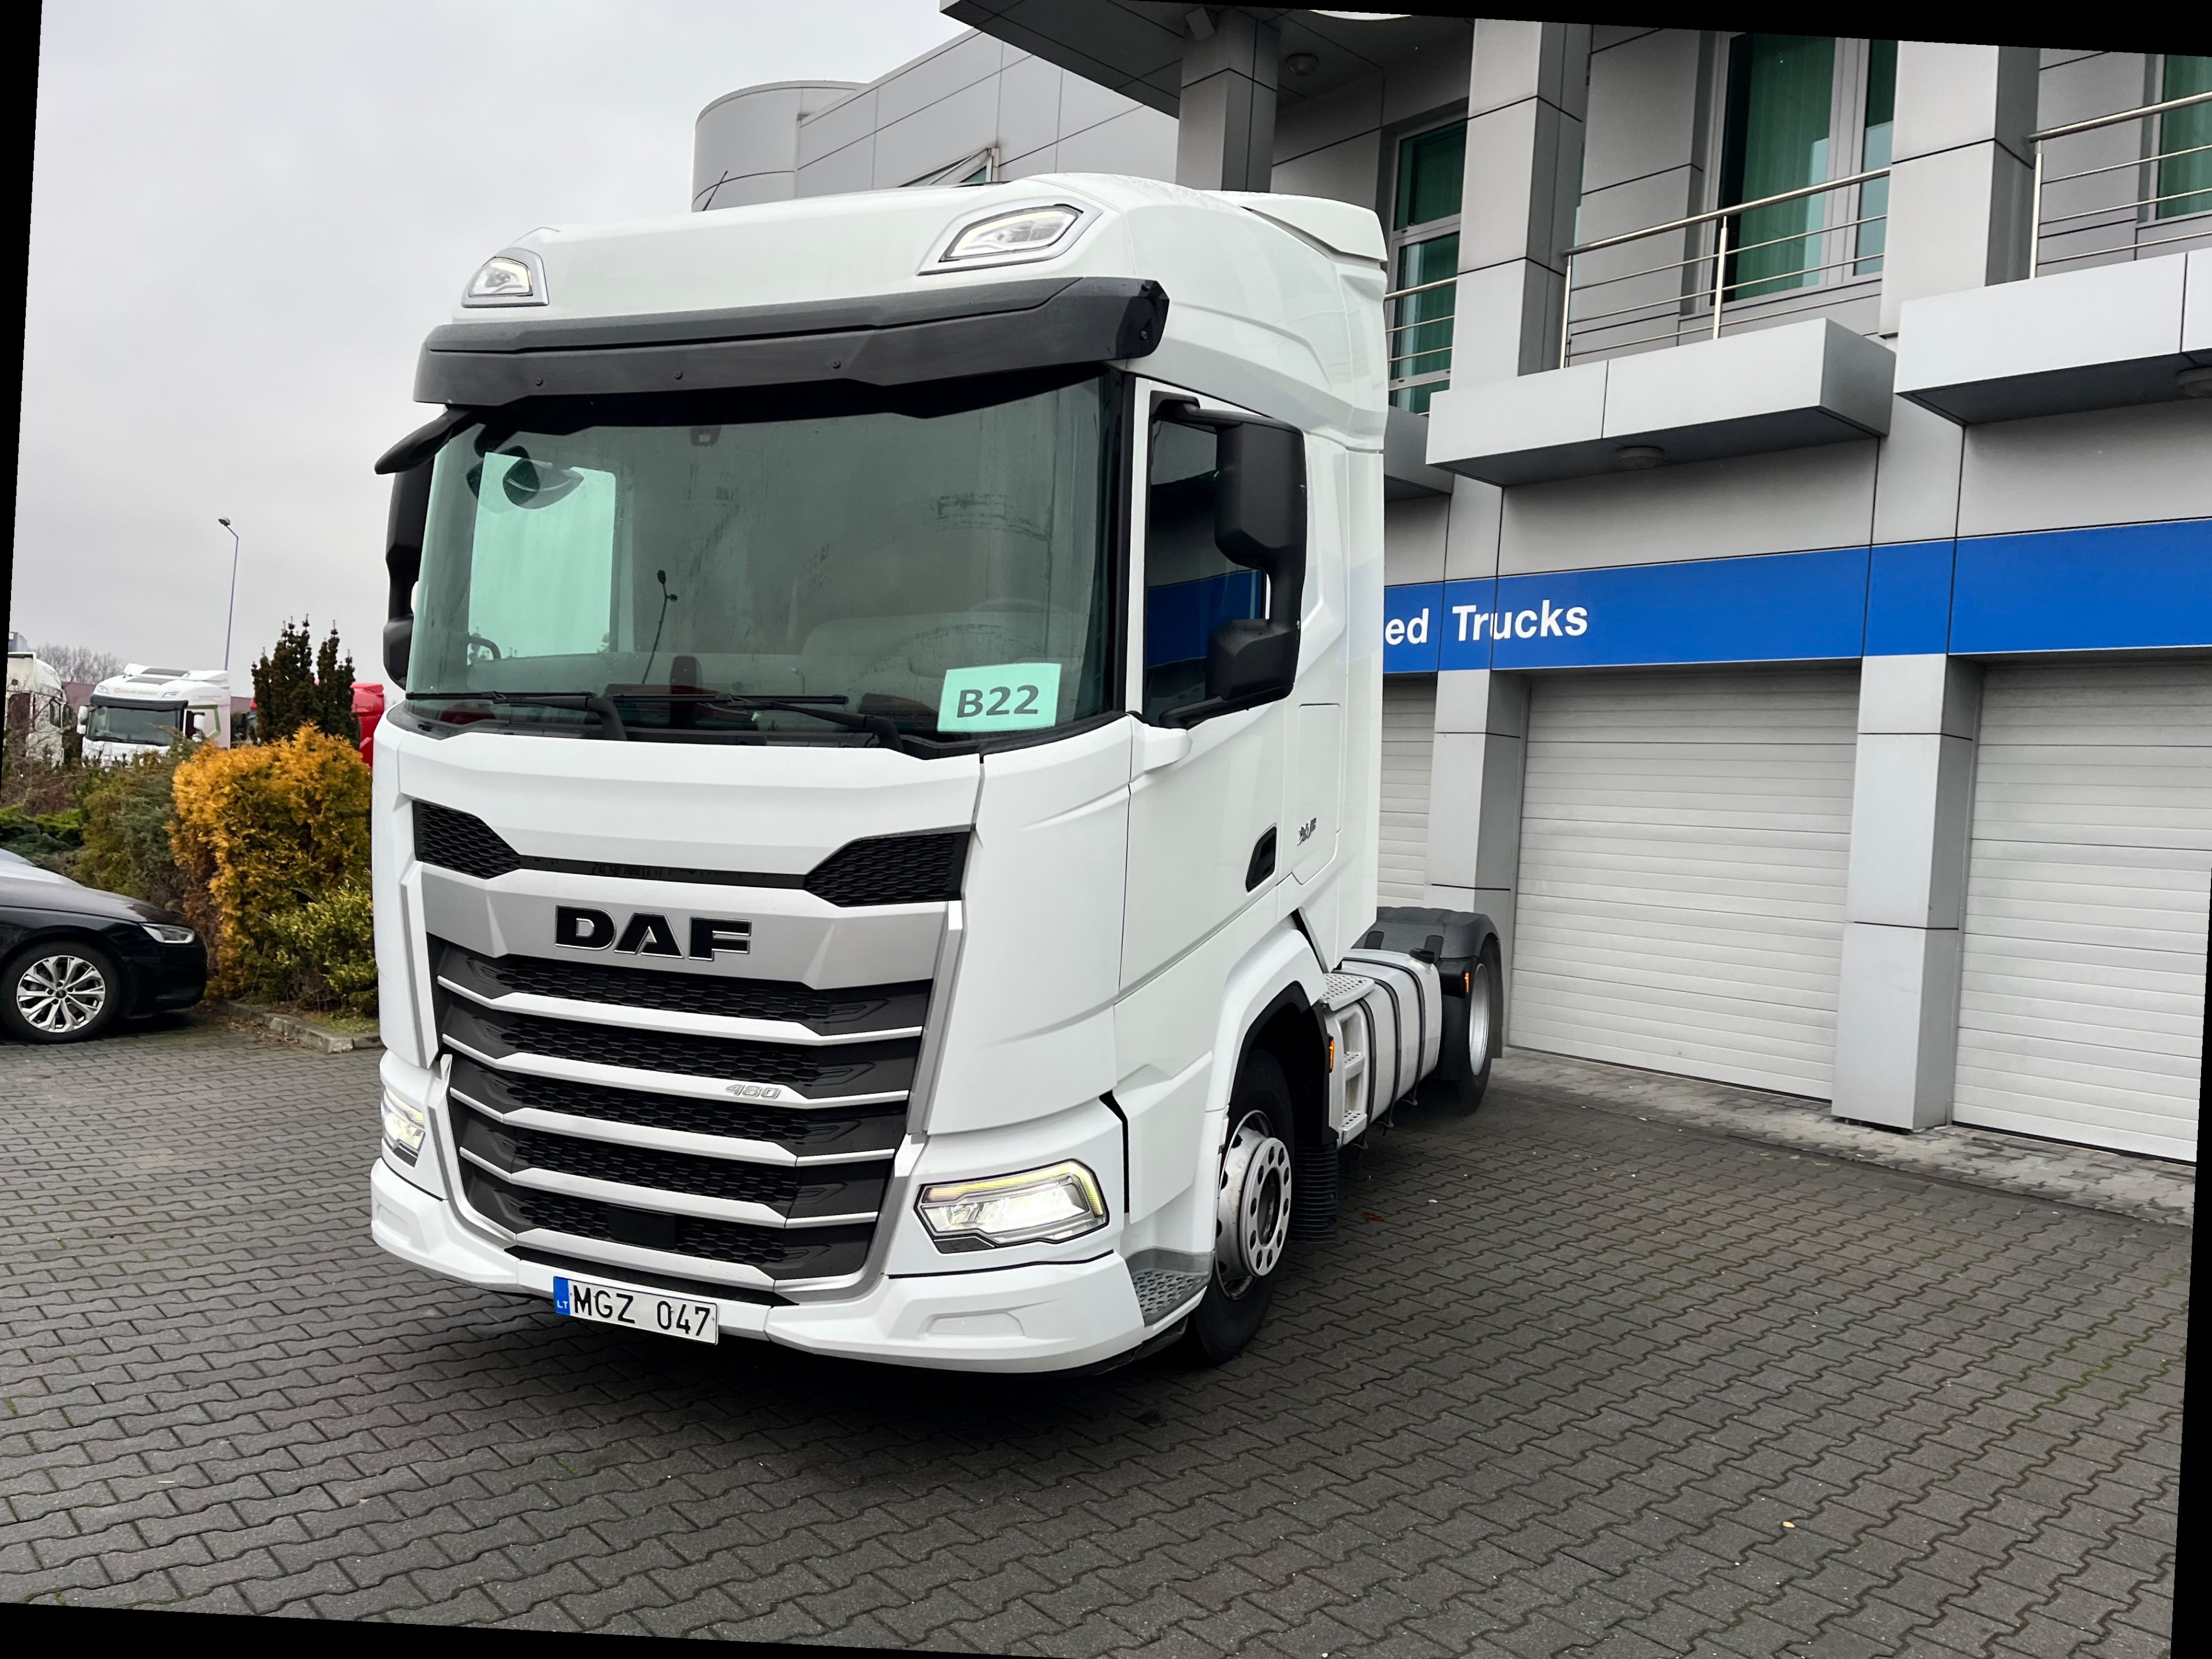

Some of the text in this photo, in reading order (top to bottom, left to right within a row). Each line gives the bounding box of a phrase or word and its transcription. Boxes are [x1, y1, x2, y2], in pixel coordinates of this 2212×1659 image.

[1385, 599, 1588, 645] ed Trucks
[957, 684, 1039, 718] B22
[554, 904, 752, 961] DAF
[725, 1084, 781, 1099] 480
[557, 1285, 710, 1336] LT MGZ 047
